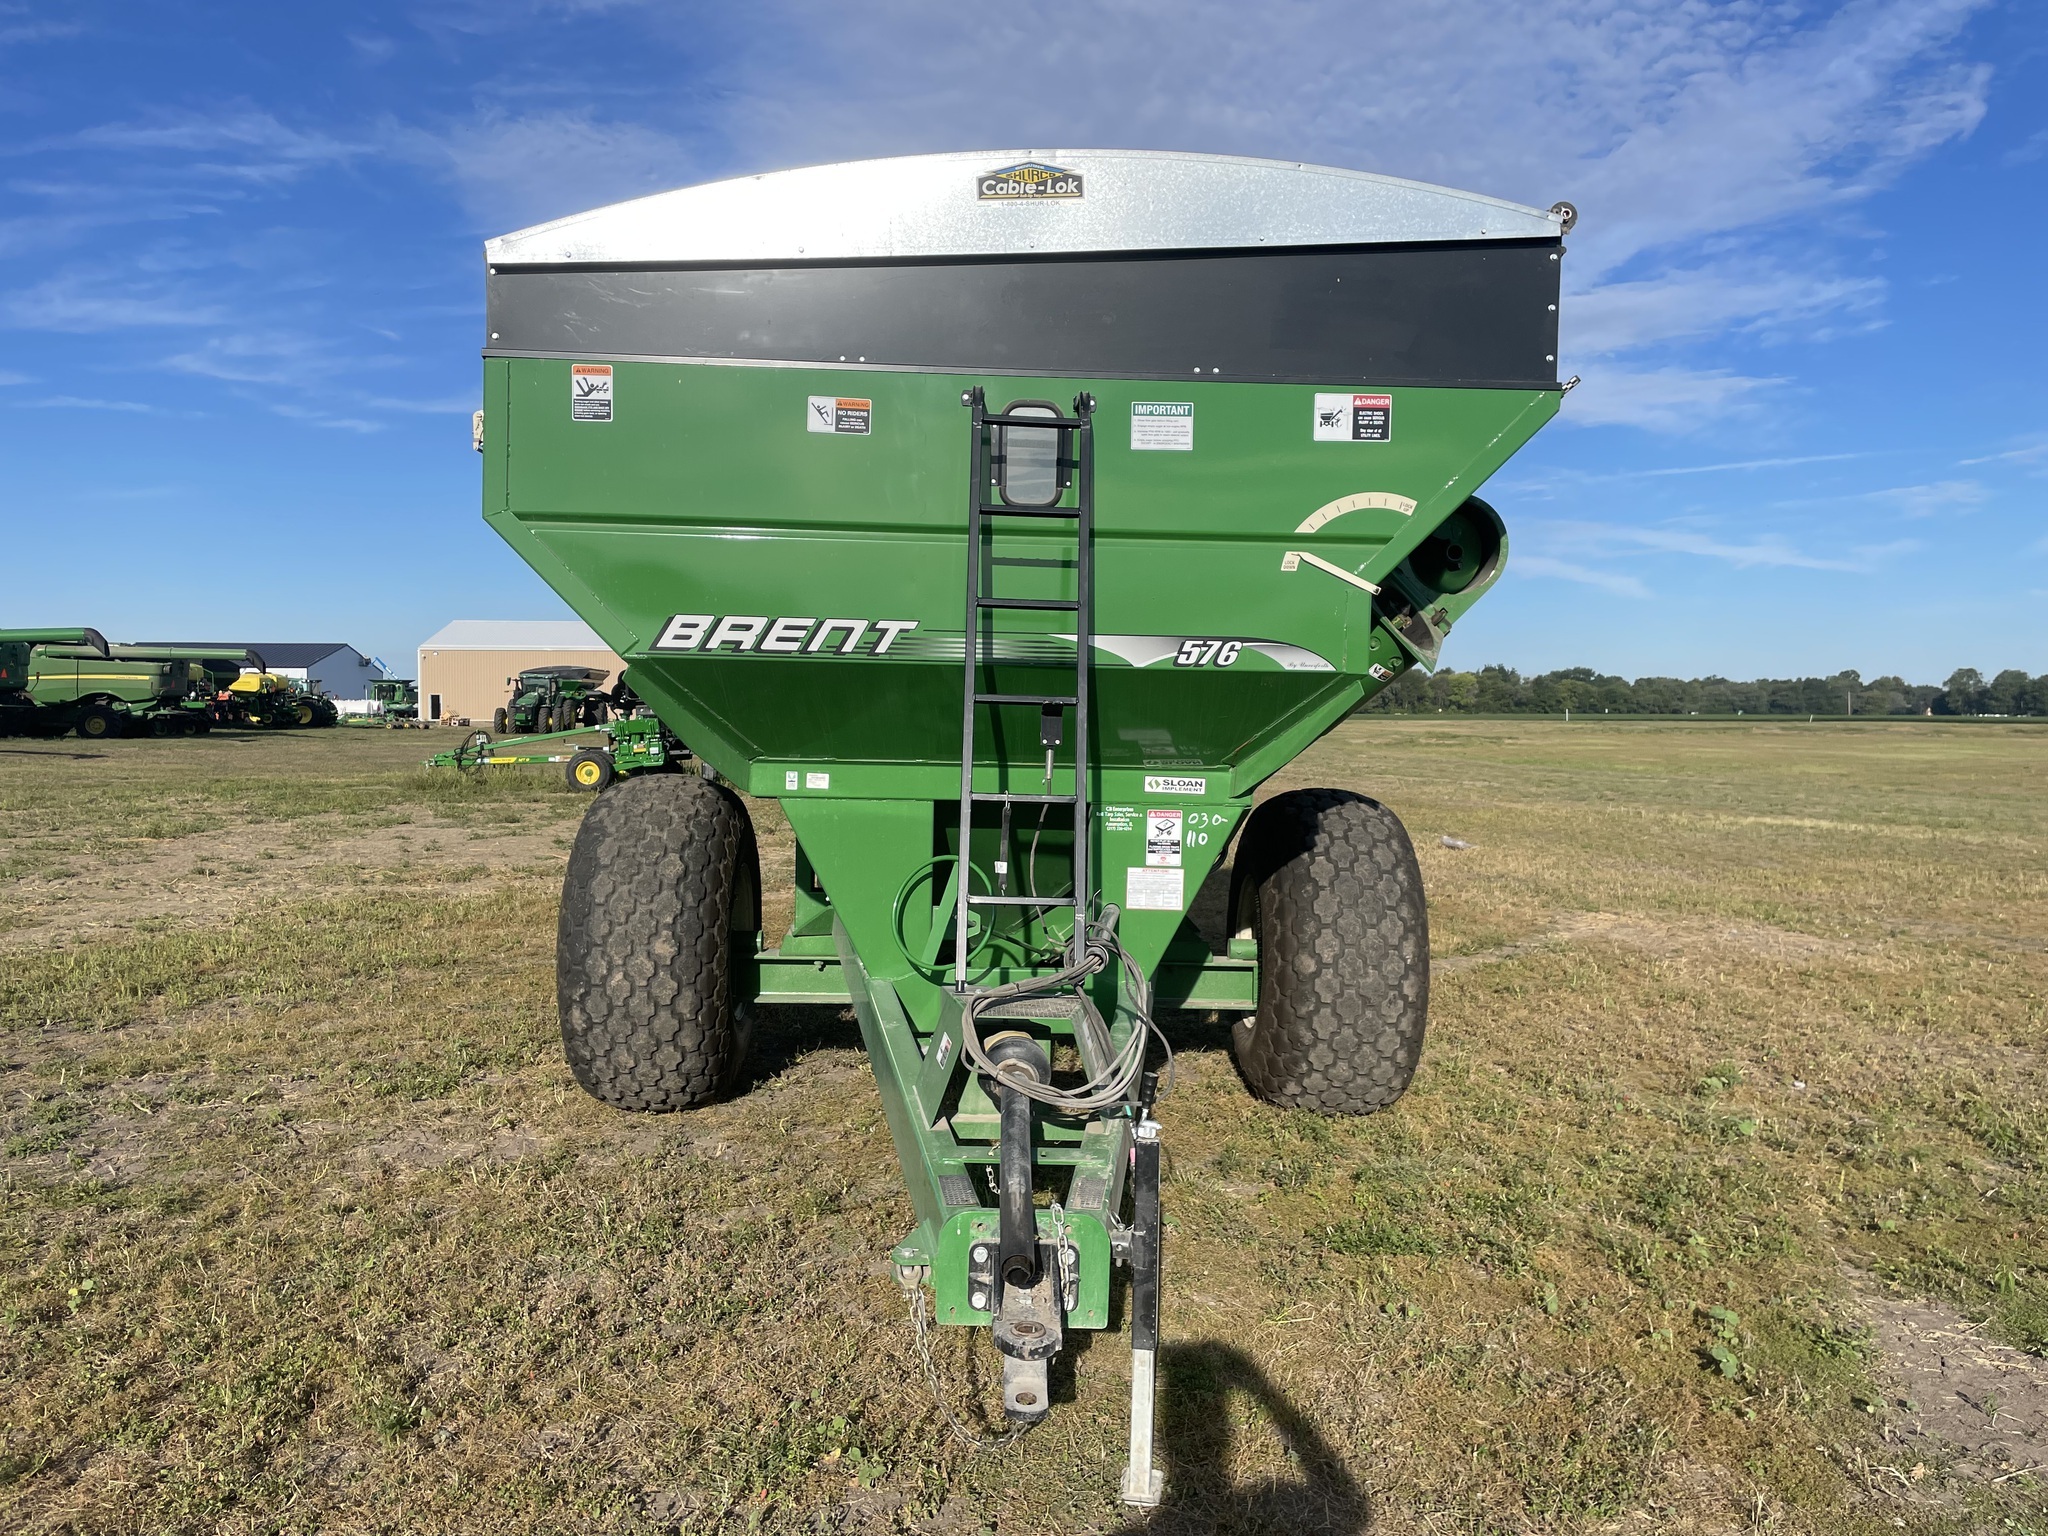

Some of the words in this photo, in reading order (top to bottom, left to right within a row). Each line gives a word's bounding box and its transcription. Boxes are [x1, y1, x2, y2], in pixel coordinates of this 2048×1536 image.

[981, 178, 1080, 195] Cable-Lok
[1135, 405, 1190, 415] IMPORTANT
[651, 614, 920, 655] BRENT
[1175, 640, 1243, 667] 576
[1162, 779, 1203, 787] SLOAN
[1186, 830, 1208, 847] 110
